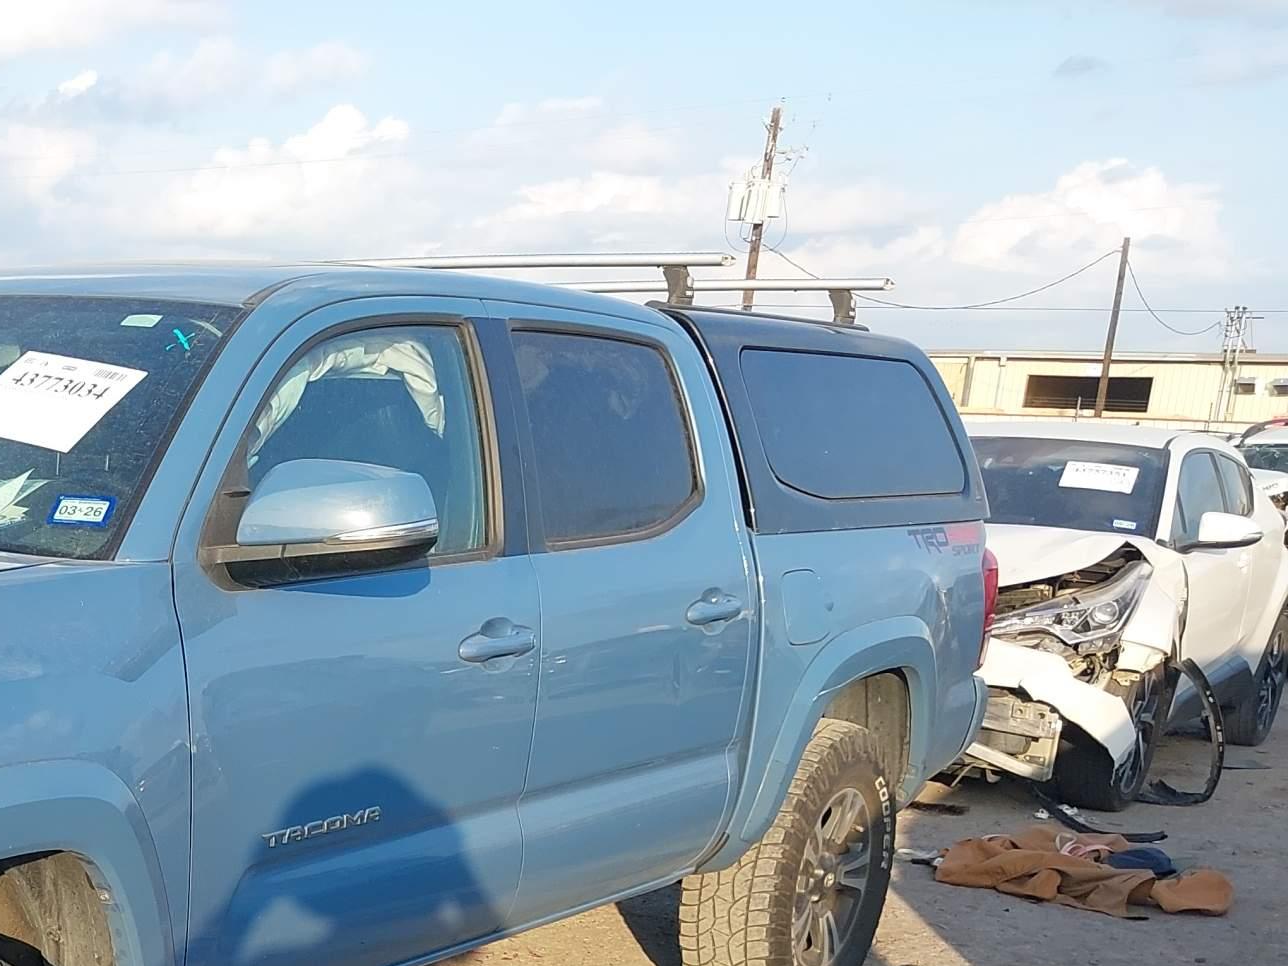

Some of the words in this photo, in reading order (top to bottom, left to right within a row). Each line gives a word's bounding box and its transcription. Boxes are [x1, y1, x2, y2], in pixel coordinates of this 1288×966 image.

[12, 371, 111, 400] 43773034
[58, 505, 78, 516] 03
[83, 506, 104, 517] 26
[906, 526, 949, 554] TRD
[261, 805, 381, 848] TACOMA
[874, 775, 892, 870] COOPER
